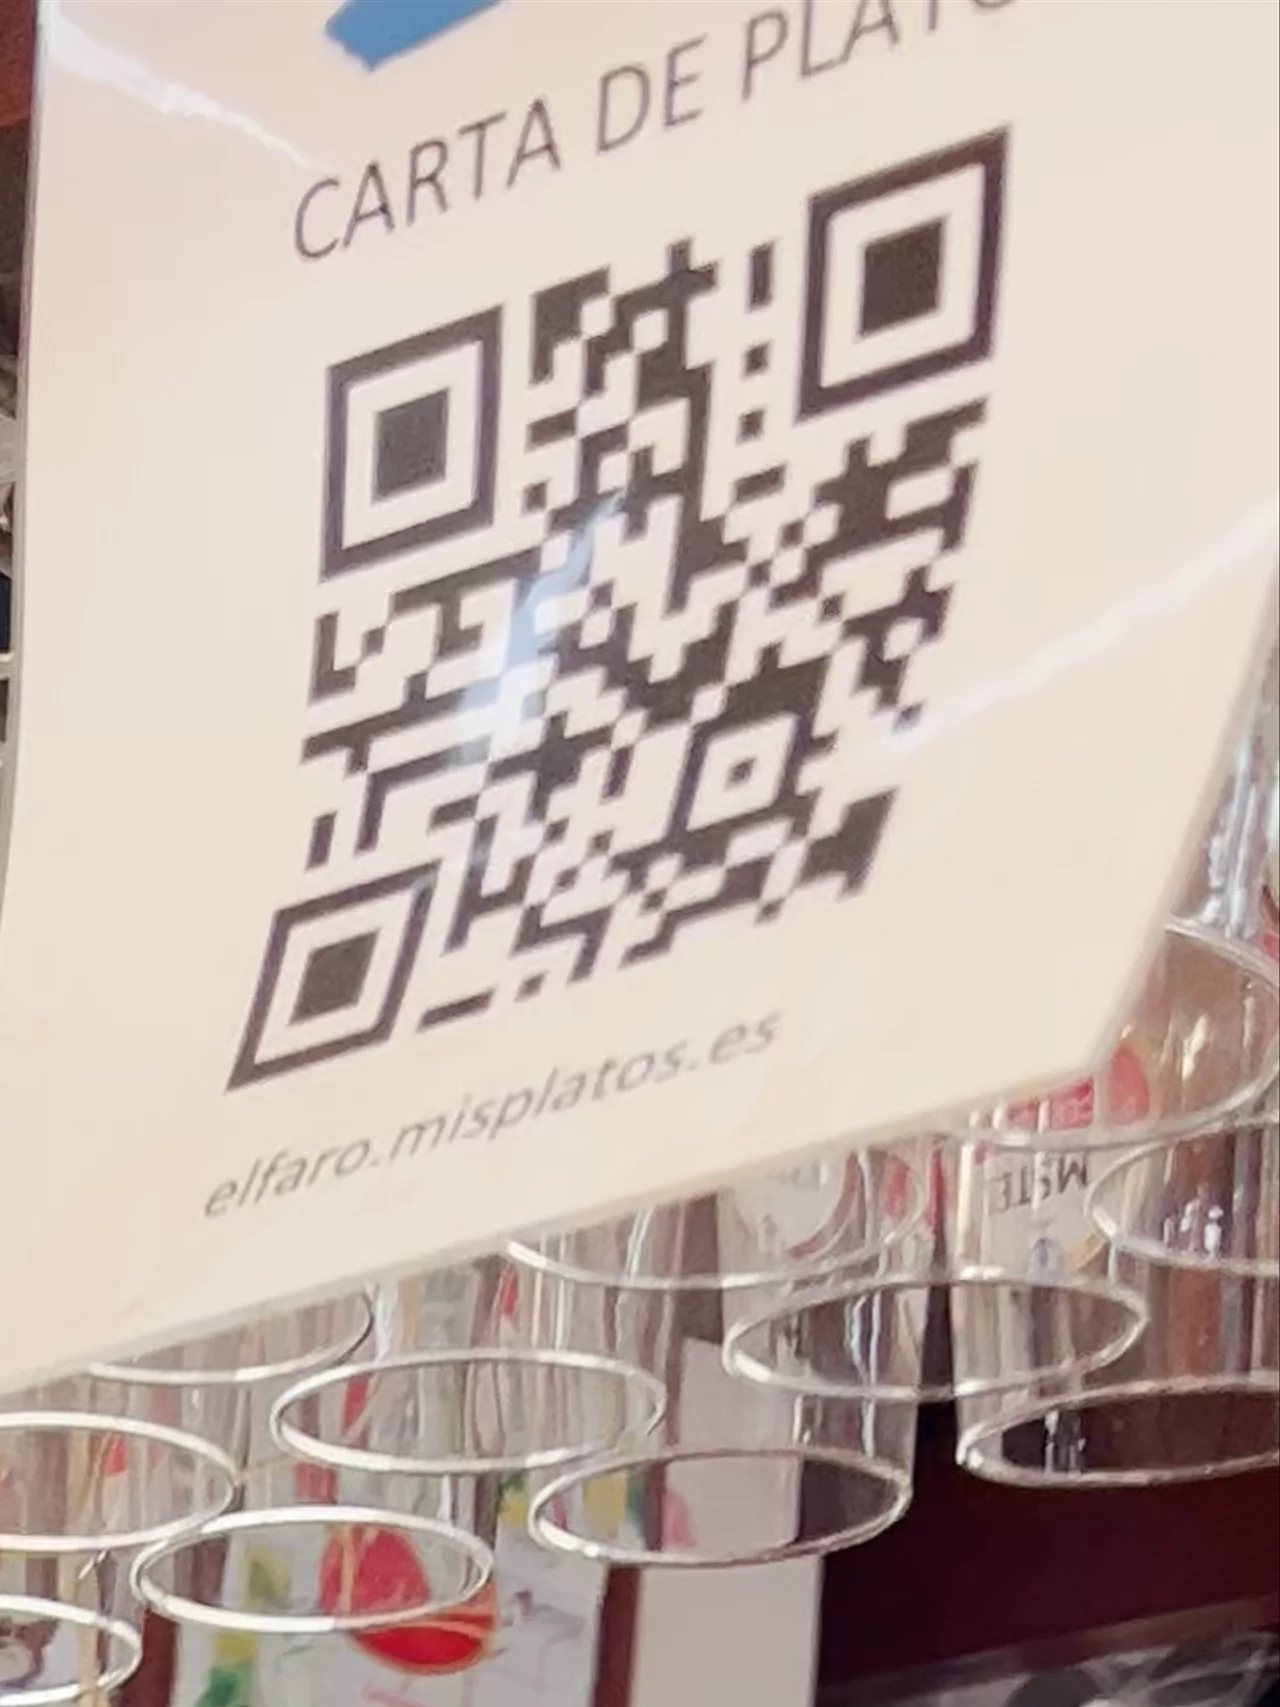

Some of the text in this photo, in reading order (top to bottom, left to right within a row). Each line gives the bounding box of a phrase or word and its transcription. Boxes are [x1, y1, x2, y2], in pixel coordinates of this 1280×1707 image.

[293, 96, 561, 260] CARTA
[596, 34, 709, 154] DE
[203, 1010, 783, 1219] elfaro.misplatos.es
